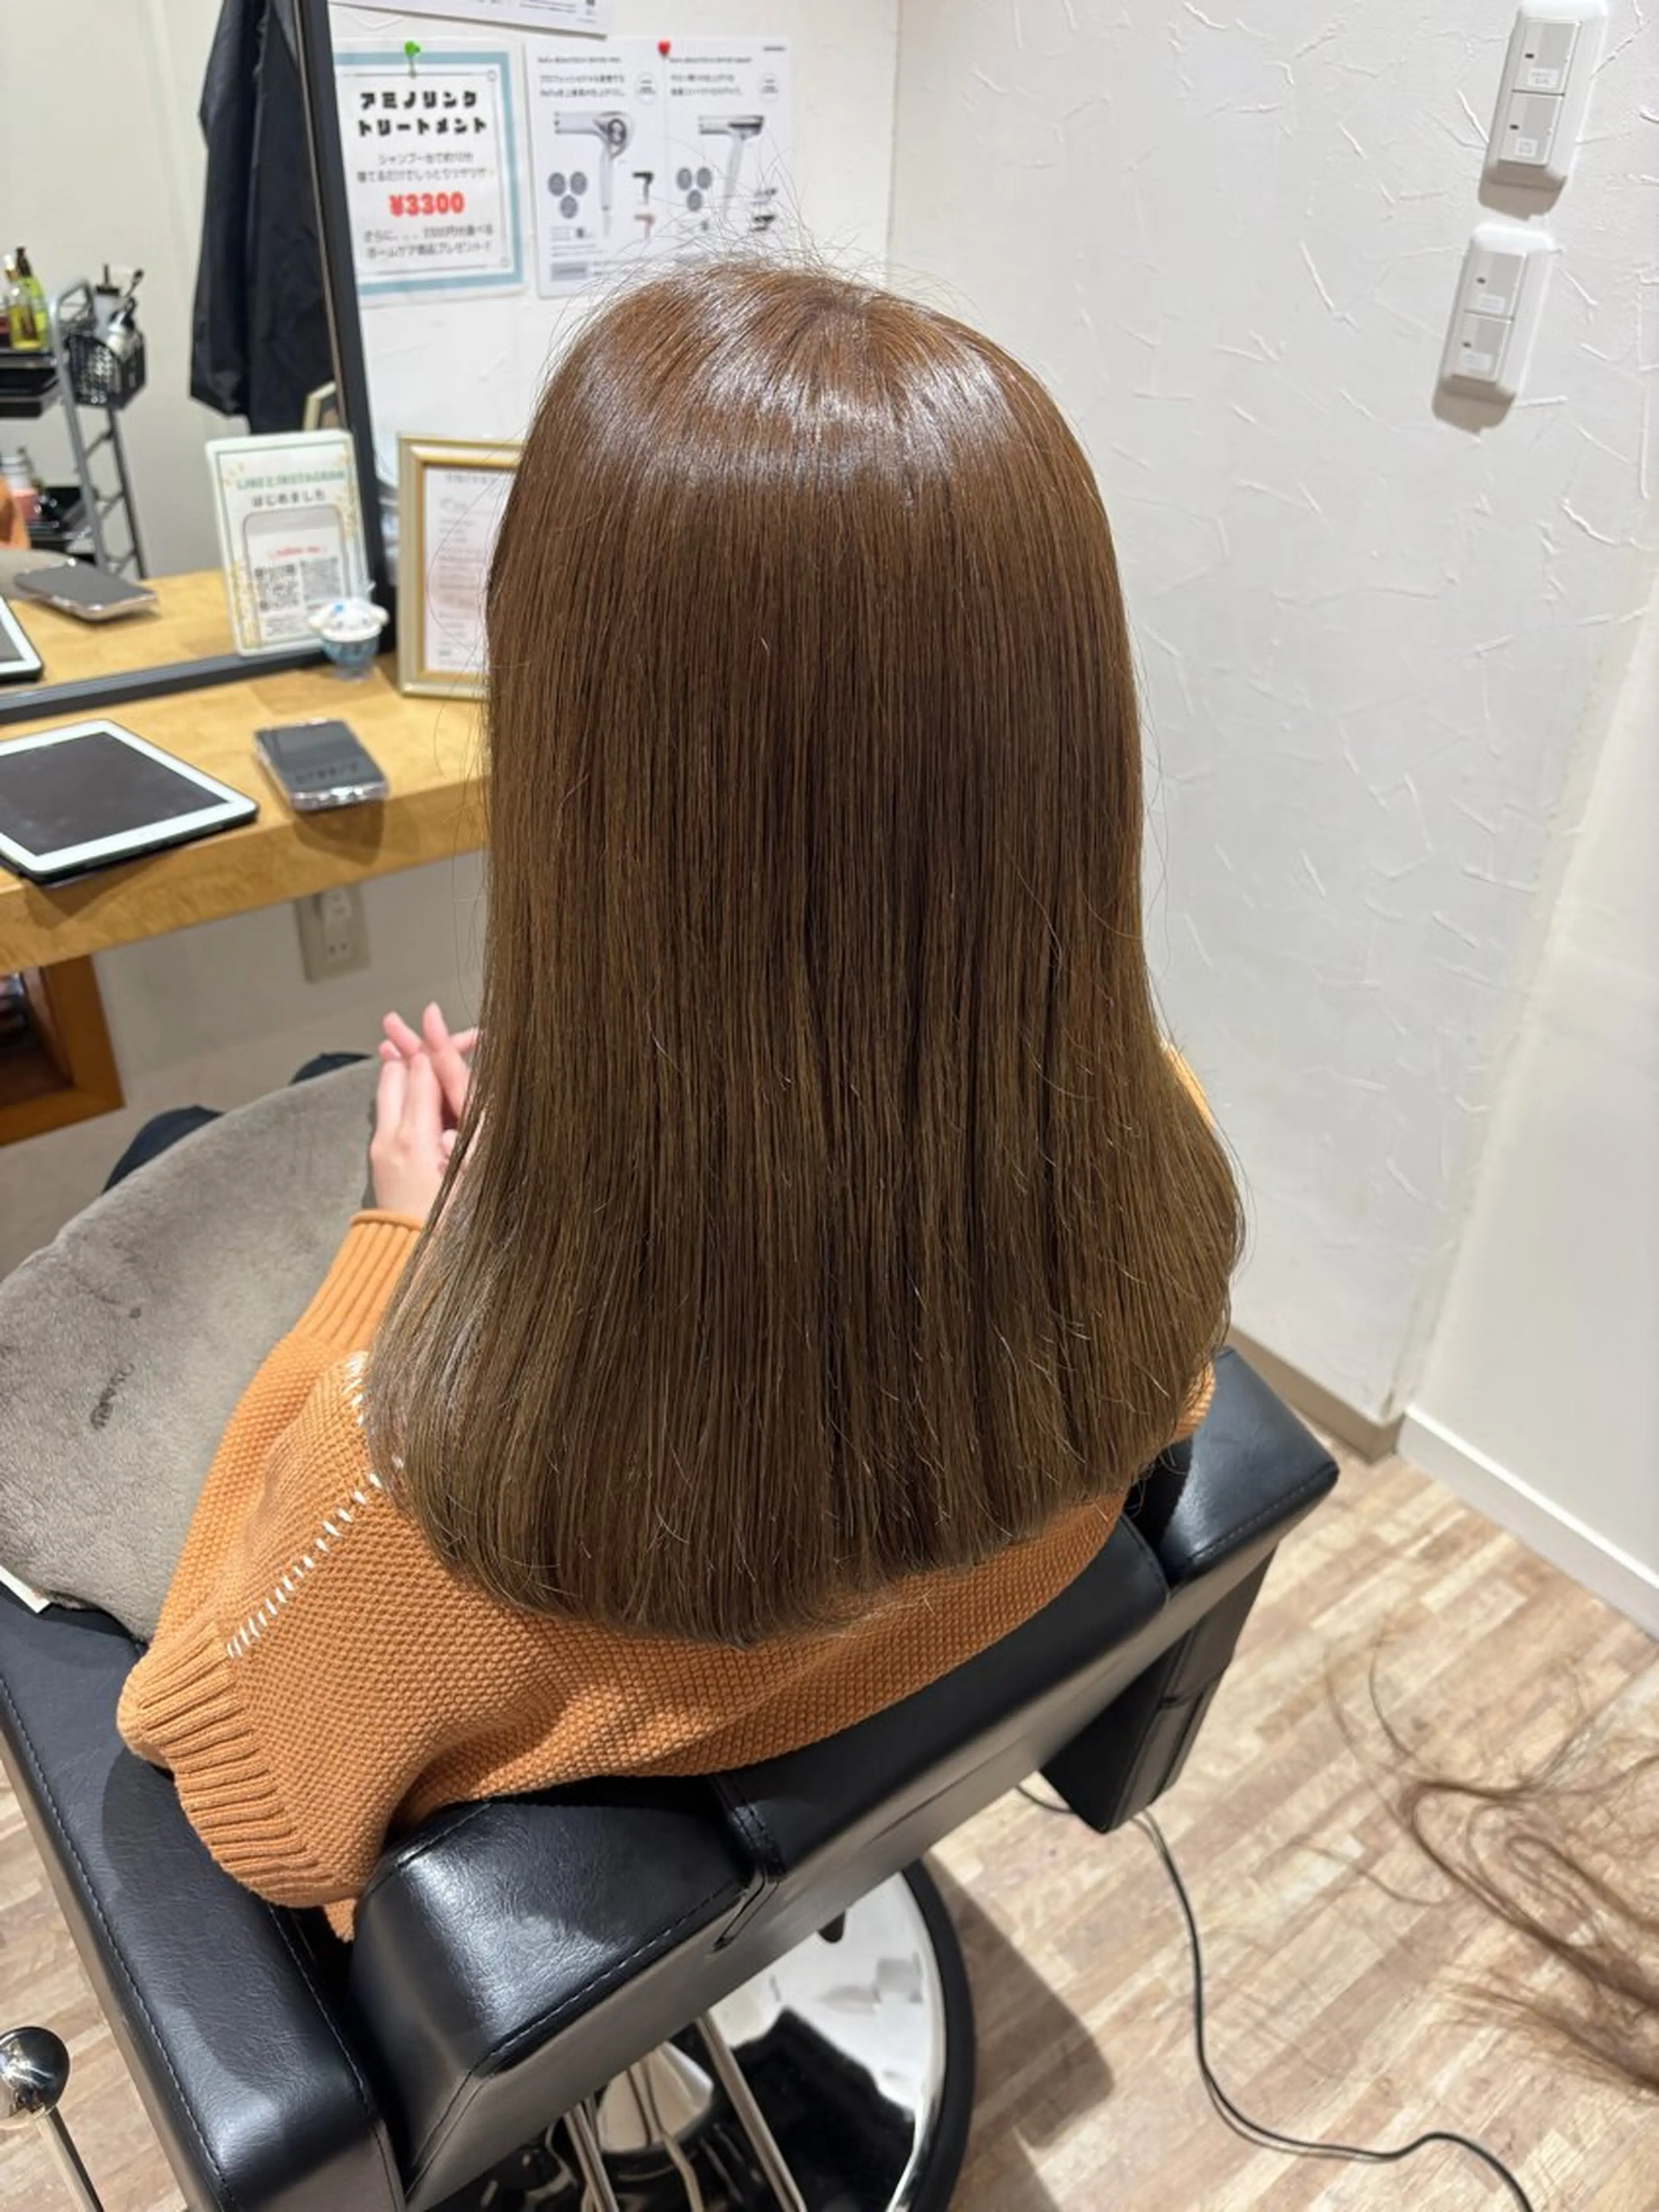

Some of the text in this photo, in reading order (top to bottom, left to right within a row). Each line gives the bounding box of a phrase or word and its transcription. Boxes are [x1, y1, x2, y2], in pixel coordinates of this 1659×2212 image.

[360, 90, 477, 111] アミノリンク
[358, 116, 486, 137] トリートメント
[253, 489, 326, 508] はじめました
